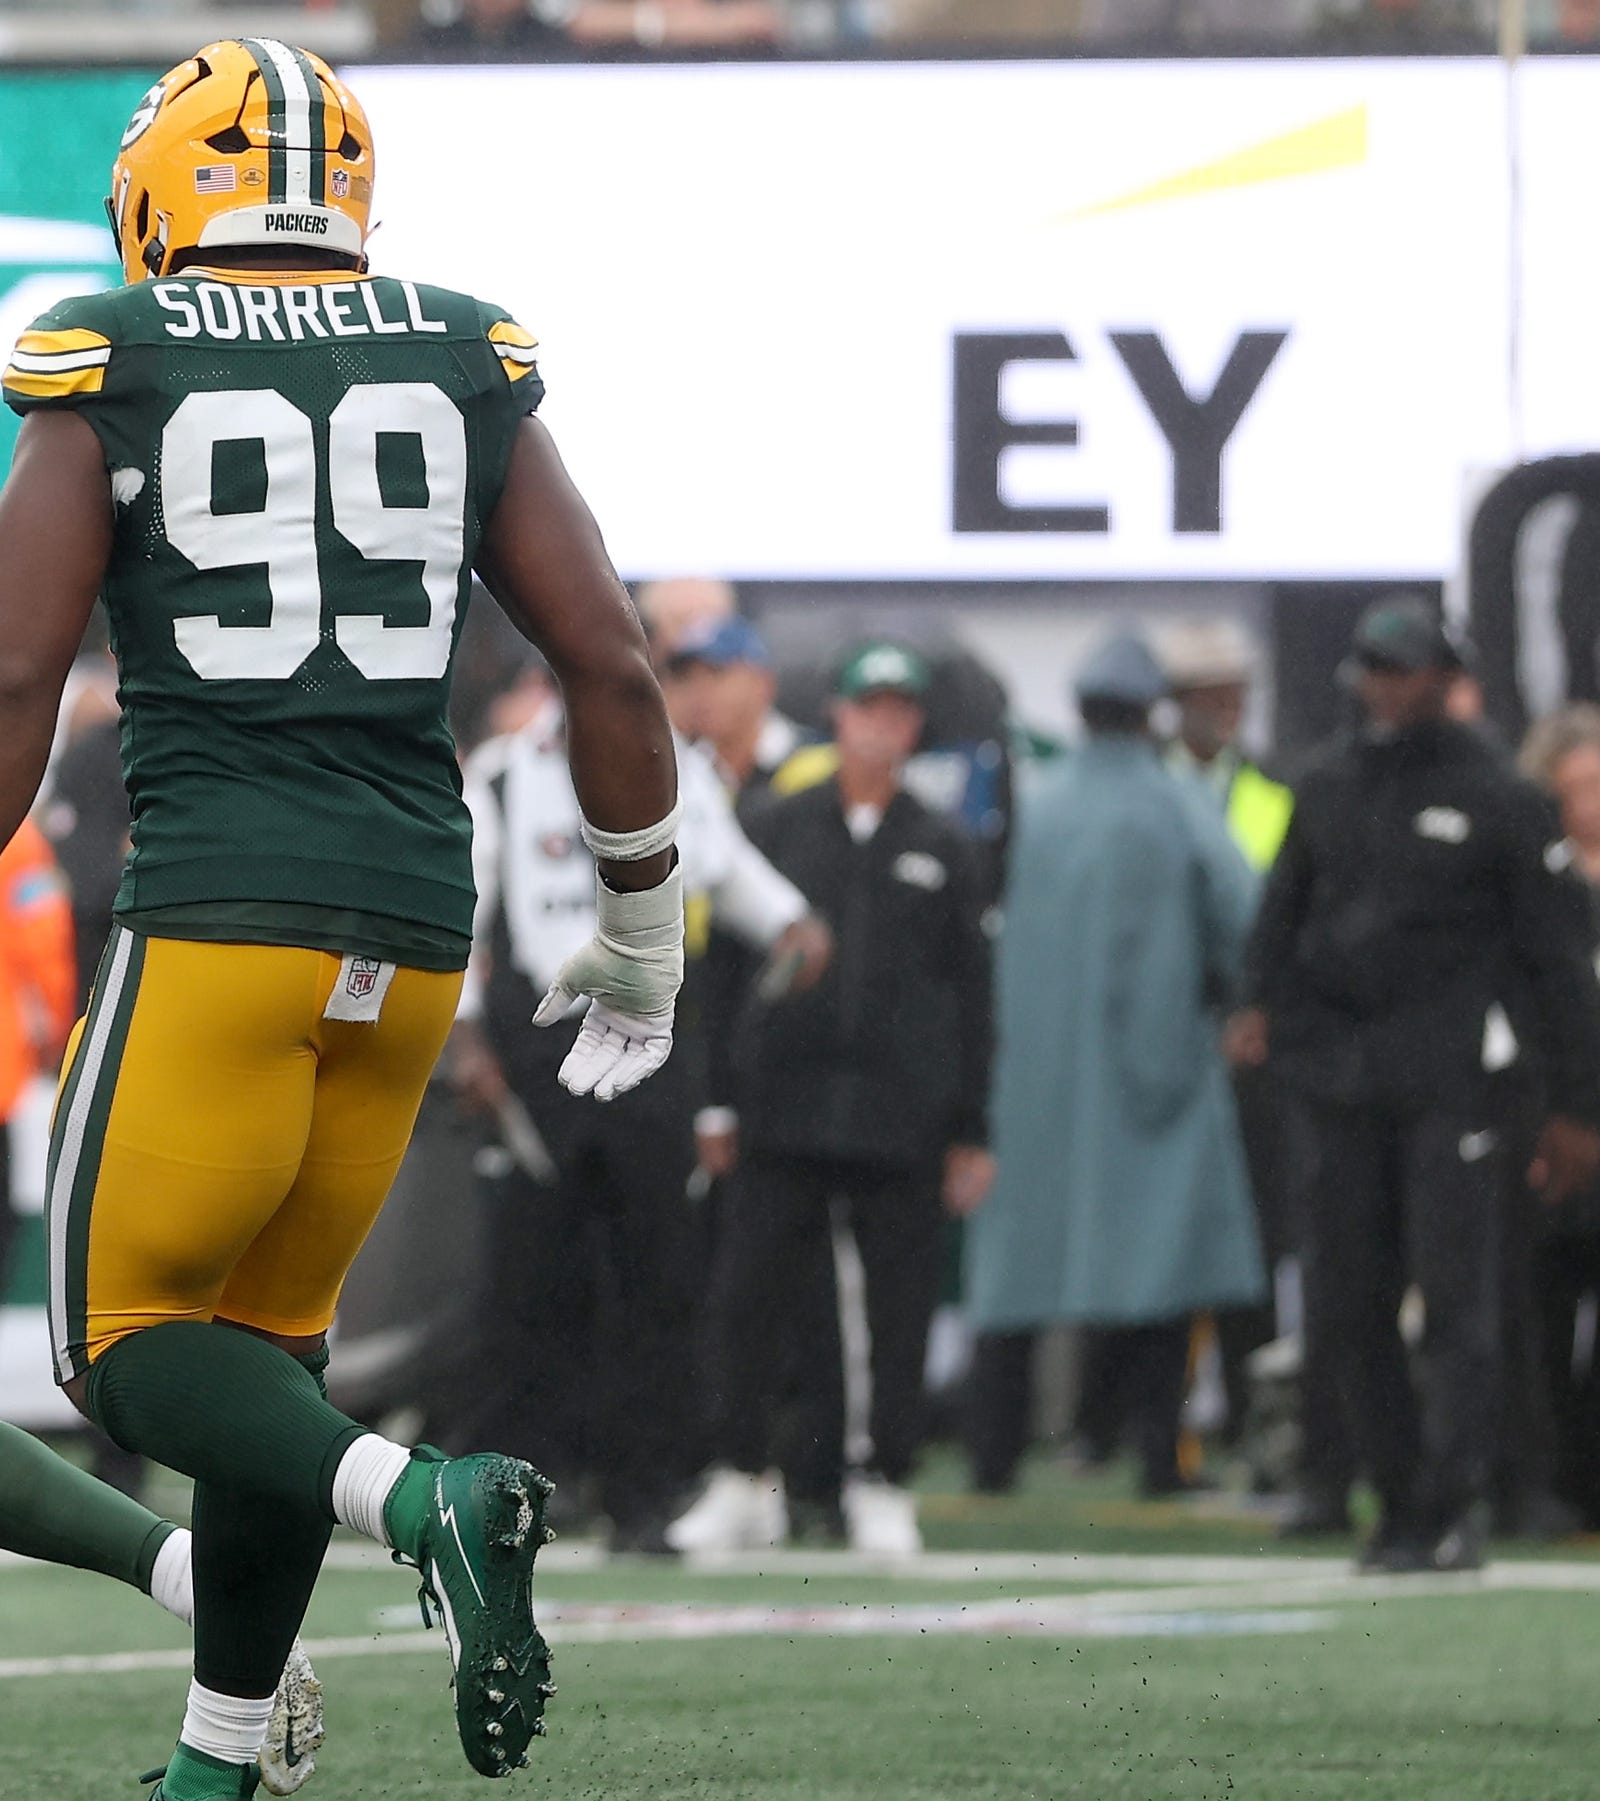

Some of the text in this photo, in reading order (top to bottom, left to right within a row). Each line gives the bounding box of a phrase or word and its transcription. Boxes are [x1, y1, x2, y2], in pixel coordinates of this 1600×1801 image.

[264, 213, 329, 235] PACKERS
[152, 281, 448, 341] SORRELL
[952, 330, 1289, 533] EY
[161, 382, 467, 680] 99
